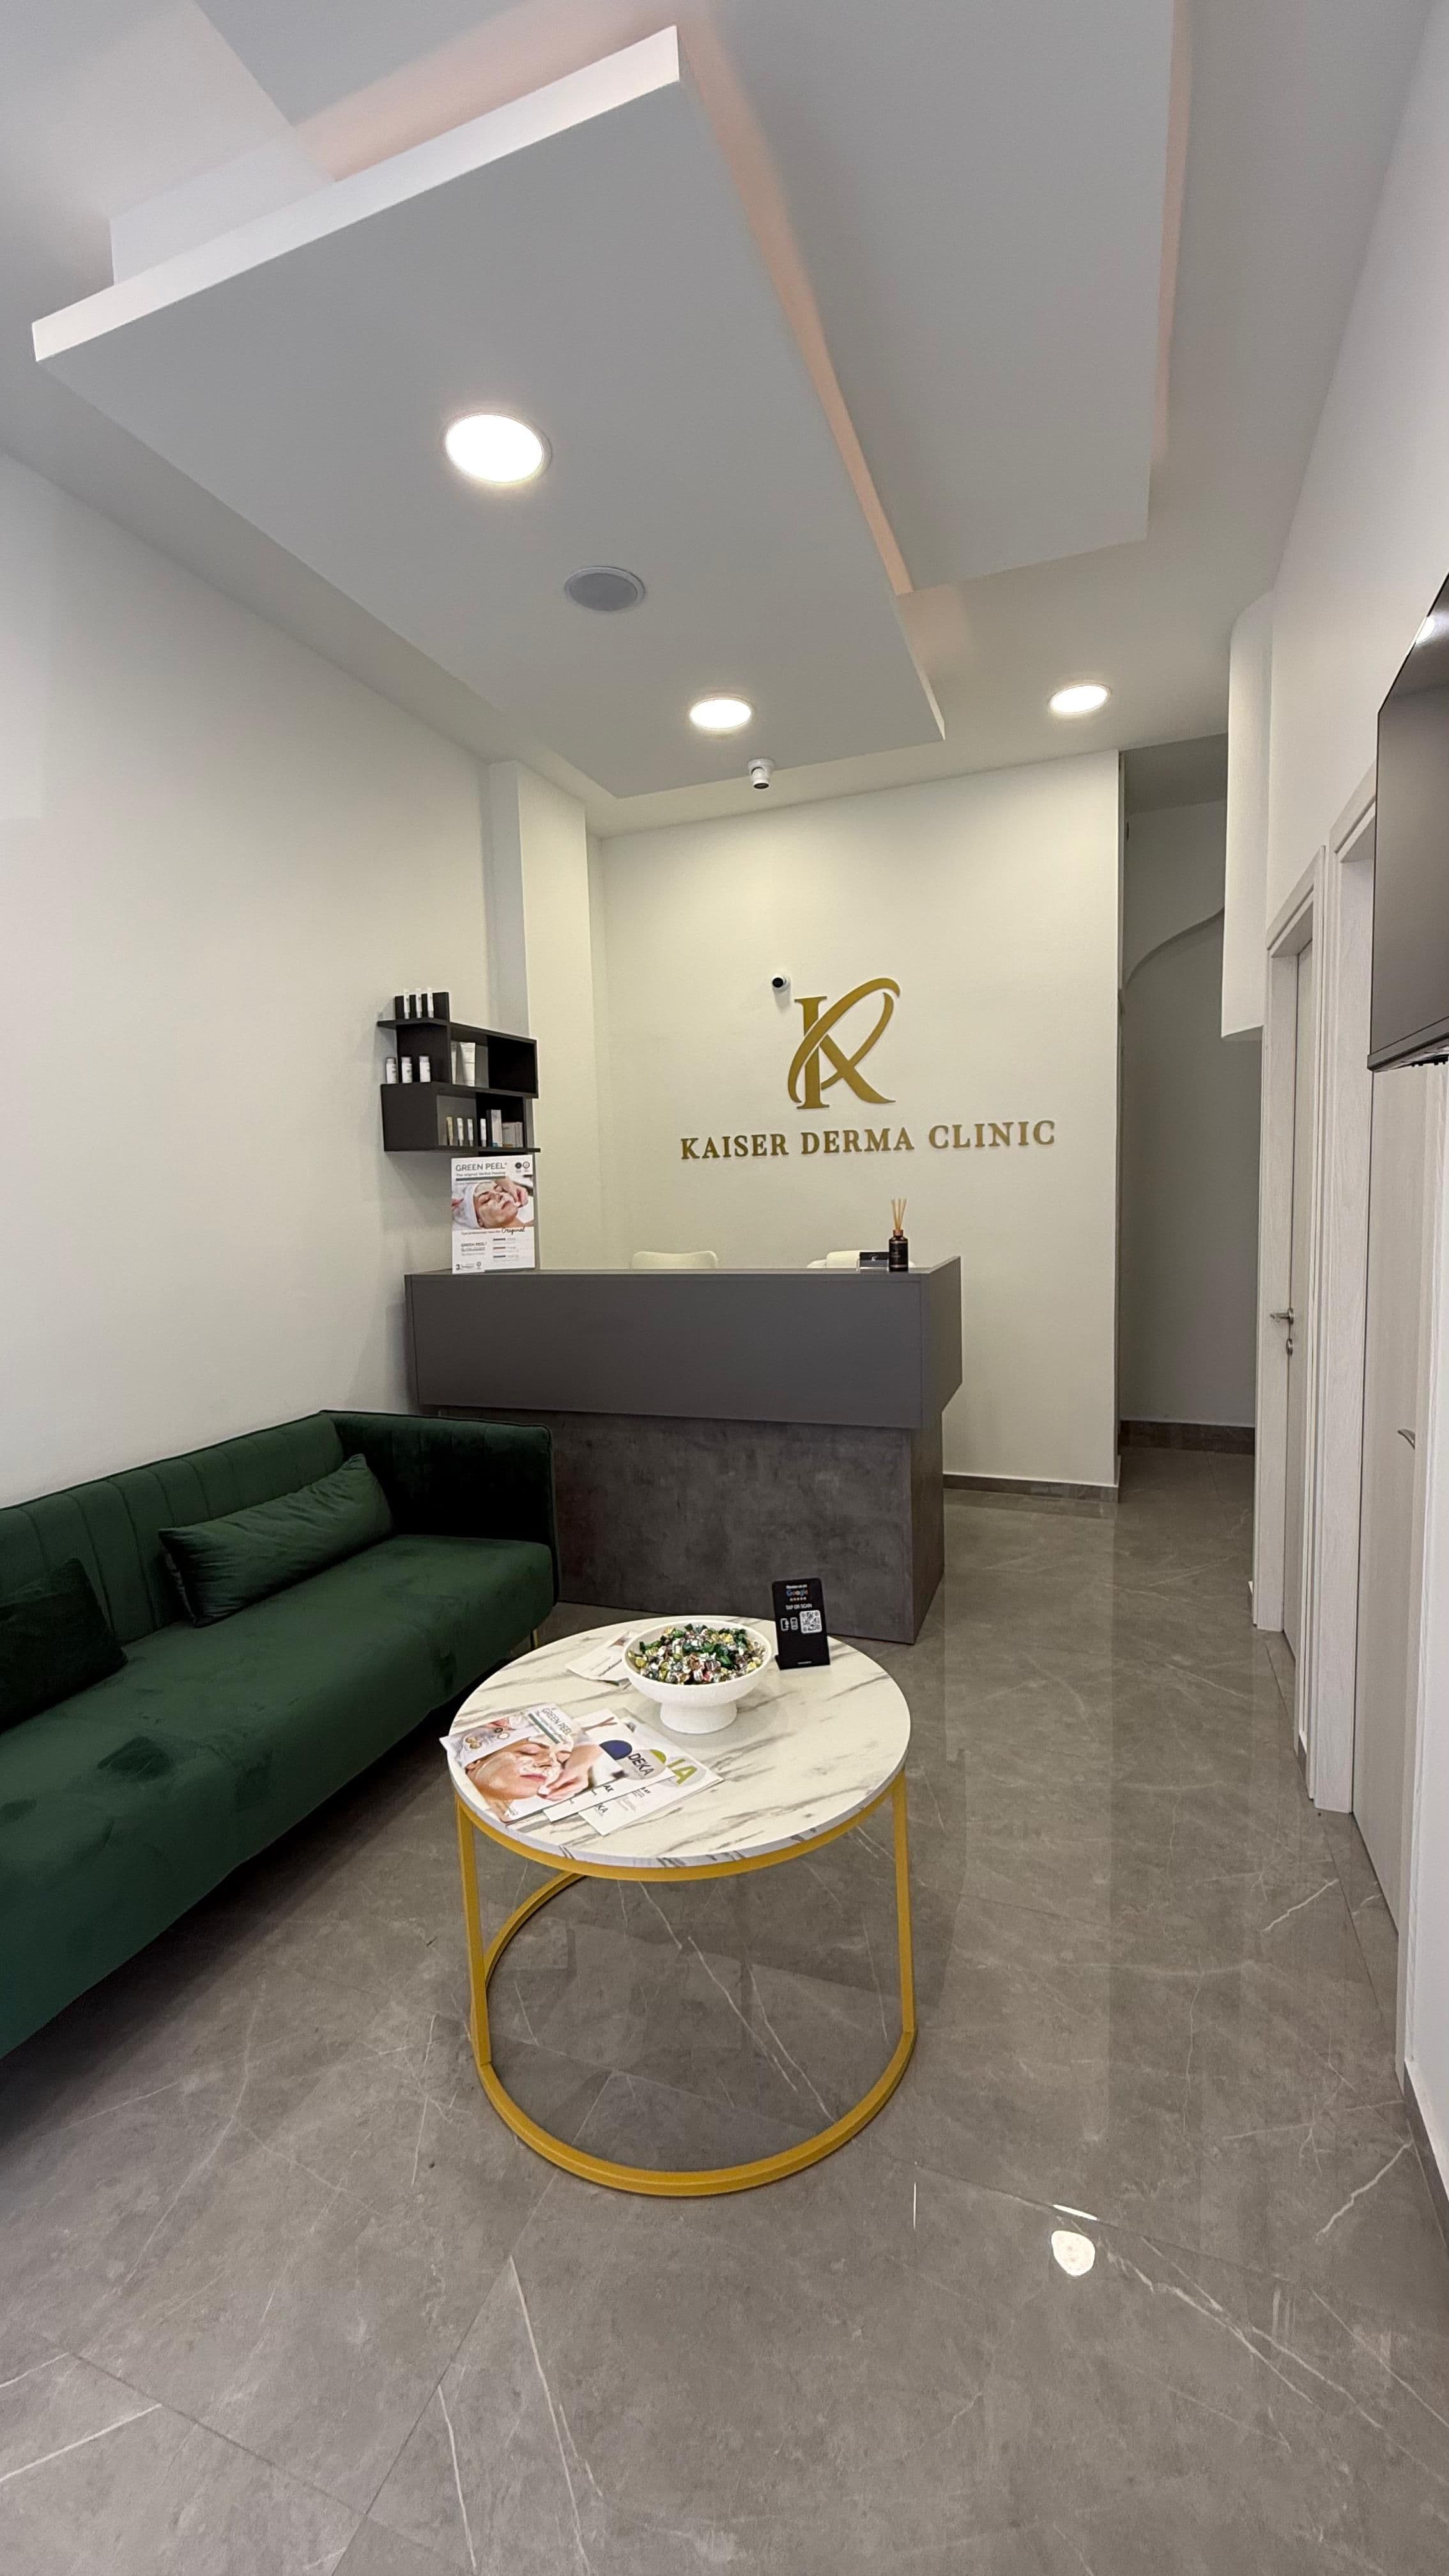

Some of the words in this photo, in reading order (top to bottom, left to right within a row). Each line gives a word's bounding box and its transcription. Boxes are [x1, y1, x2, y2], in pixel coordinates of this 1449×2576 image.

[680, 1133, 790, 1160] KAISER
[801, 1127, 915, 1155] DERMA
[928, 1120, 1055, 1149] CLINIC
[456, 1163, 484, 1172] GREEN
[627, 1752, 655, 1776] DEKA
